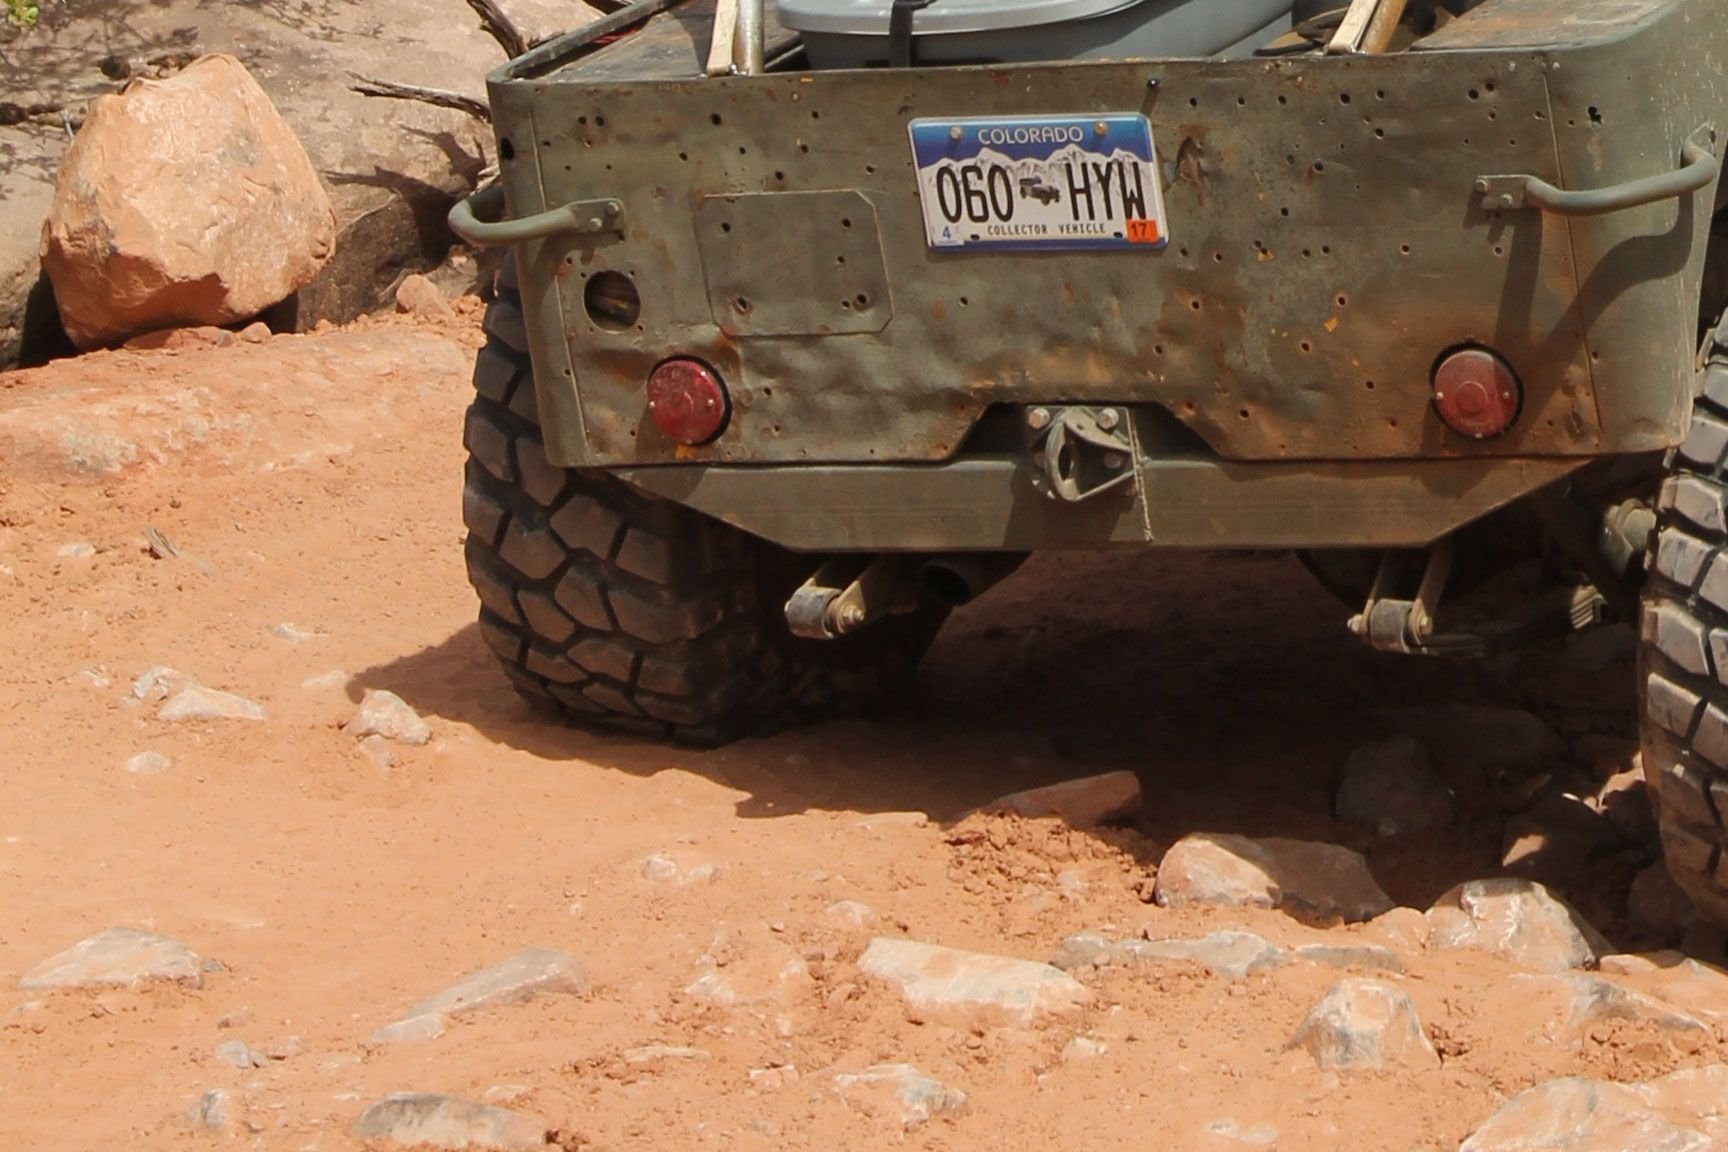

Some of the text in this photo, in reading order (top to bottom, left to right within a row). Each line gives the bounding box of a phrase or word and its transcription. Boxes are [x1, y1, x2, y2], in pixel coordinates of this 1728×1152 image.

[977, 126, 1084, 145] COLORADO
[936, 161, 1146, 223] 060 HYW
[940, 225, 952, 239] 4
[987, 223, 1106, 236] COLLECTOR VEHICLE
[1130, 222, 1149, 238] 17
